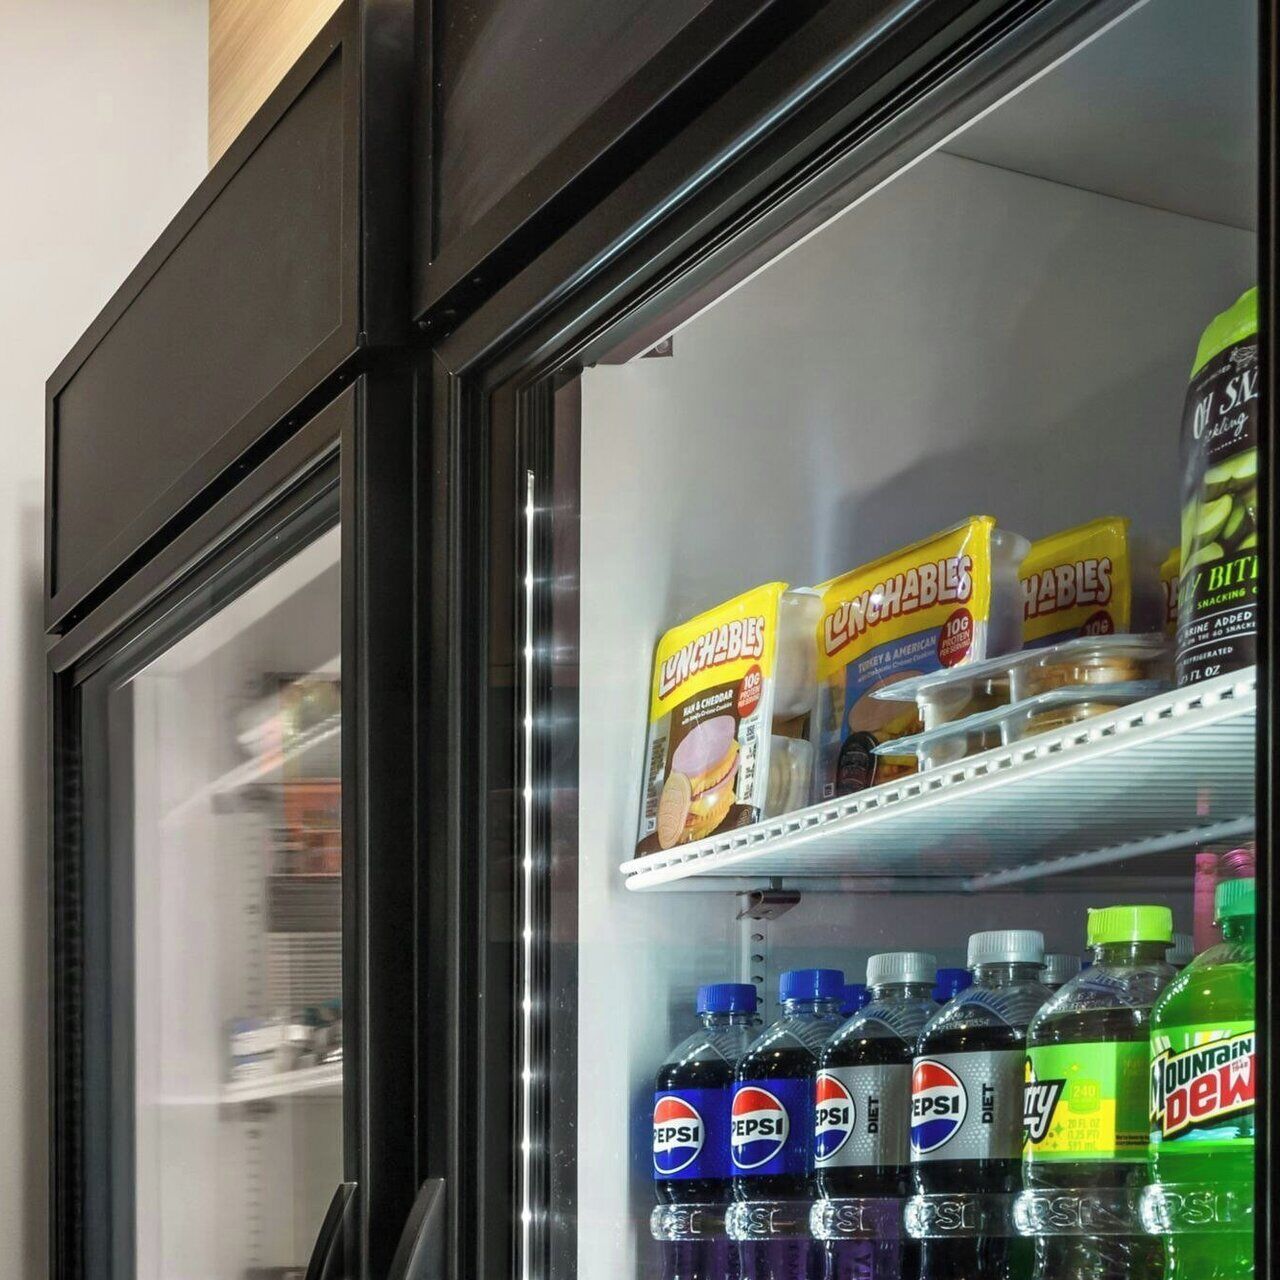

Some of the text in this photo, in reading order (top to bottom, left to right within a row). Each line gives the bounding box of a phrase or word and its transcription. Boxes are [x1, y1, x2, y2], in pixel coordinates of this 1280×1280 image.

[1021, 557, 1112, 621] HABLES
[1197, 587, 1246, 610] SNACKING
[825, 555, 972, 657] LUNCHABLES
[947, 617, 969, 635] 10G
[1215, 611, 1253, 629] ADDED
[658, 616, 765, 700] LUNCHABLES
[893, 636, 936, 660] AMERICAN
[1205, 665, 1221, 678] OZ
[1072, 1084, 1096, 1097] 240
[867, 1096, 880, 1134] DIET
[913, 1096, 959, 1116] EPSI
[981, 1083, 995, 1124] DIET
[816, 1107, 849, 1126] EPSI
